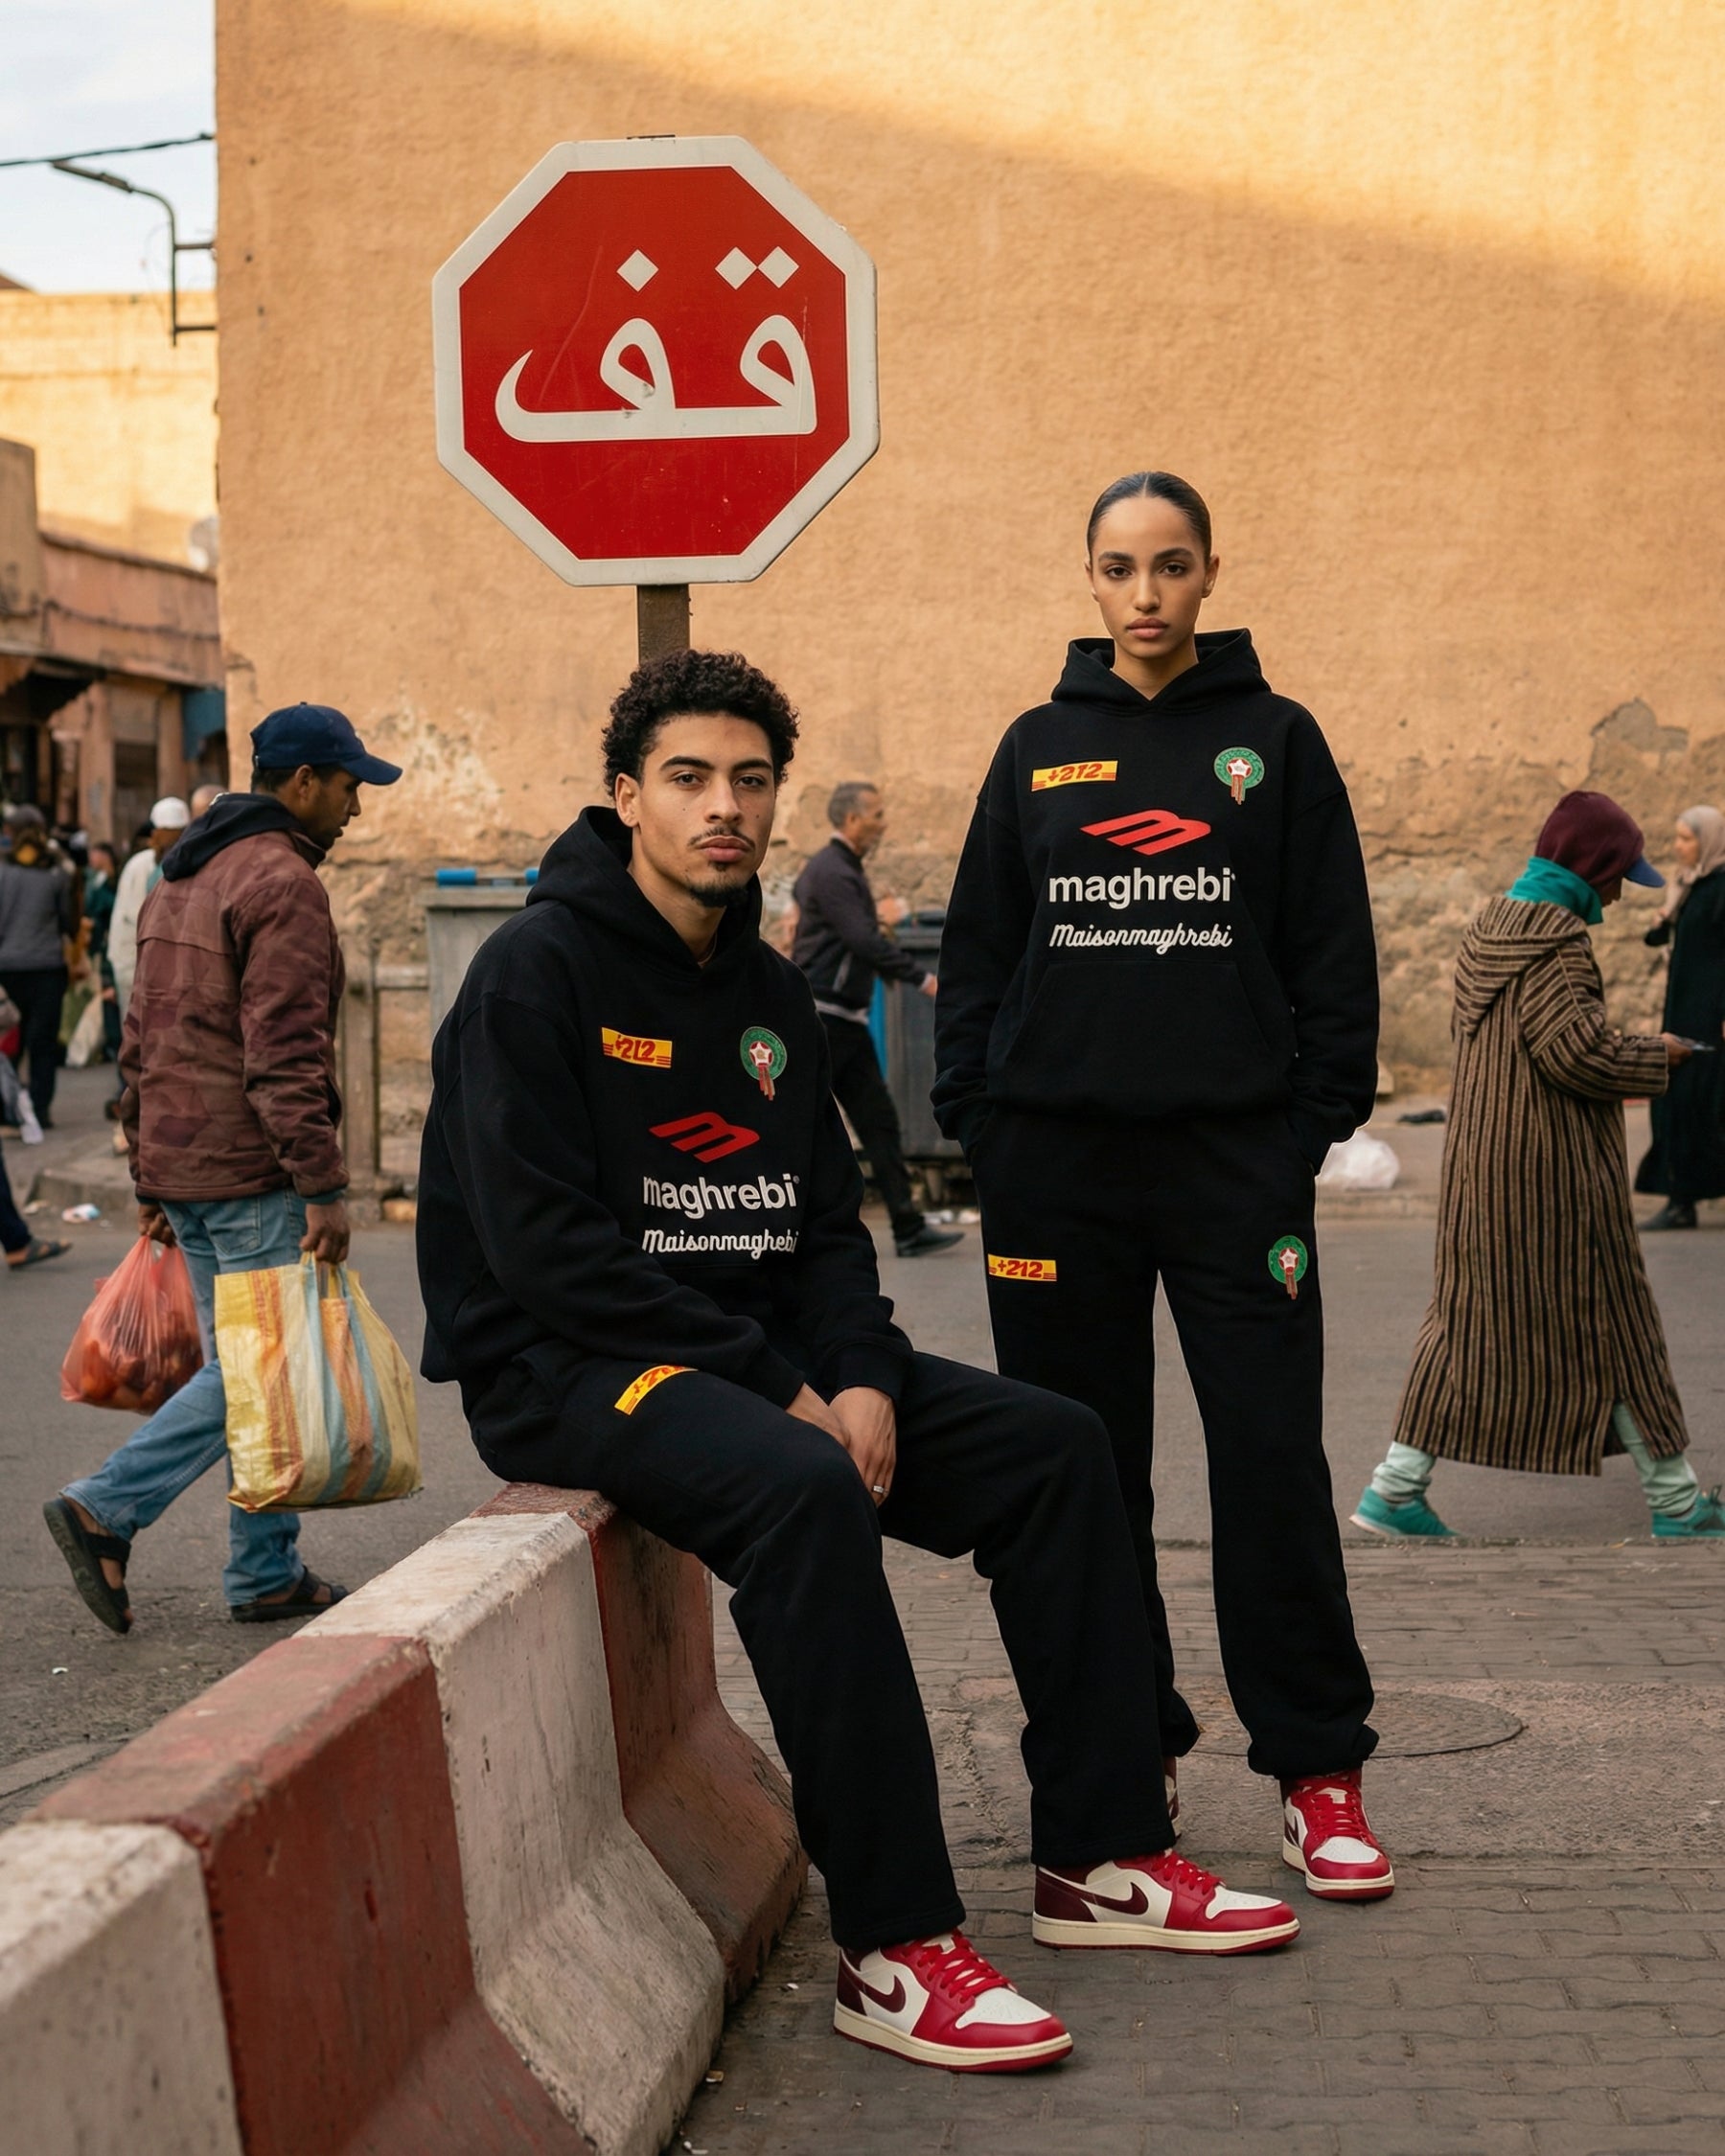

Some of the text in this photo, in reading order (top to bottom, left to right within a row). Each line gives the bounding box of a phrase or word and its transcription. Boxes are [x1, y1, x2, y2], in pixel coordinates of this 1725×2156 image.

[494, 245, 817, 444] قف
[1047, 763, 1103, 783] +212
[1048, 923, 1233, 955] Maisonmaghrebi
[997, 1259, 1044, 1278] +212
